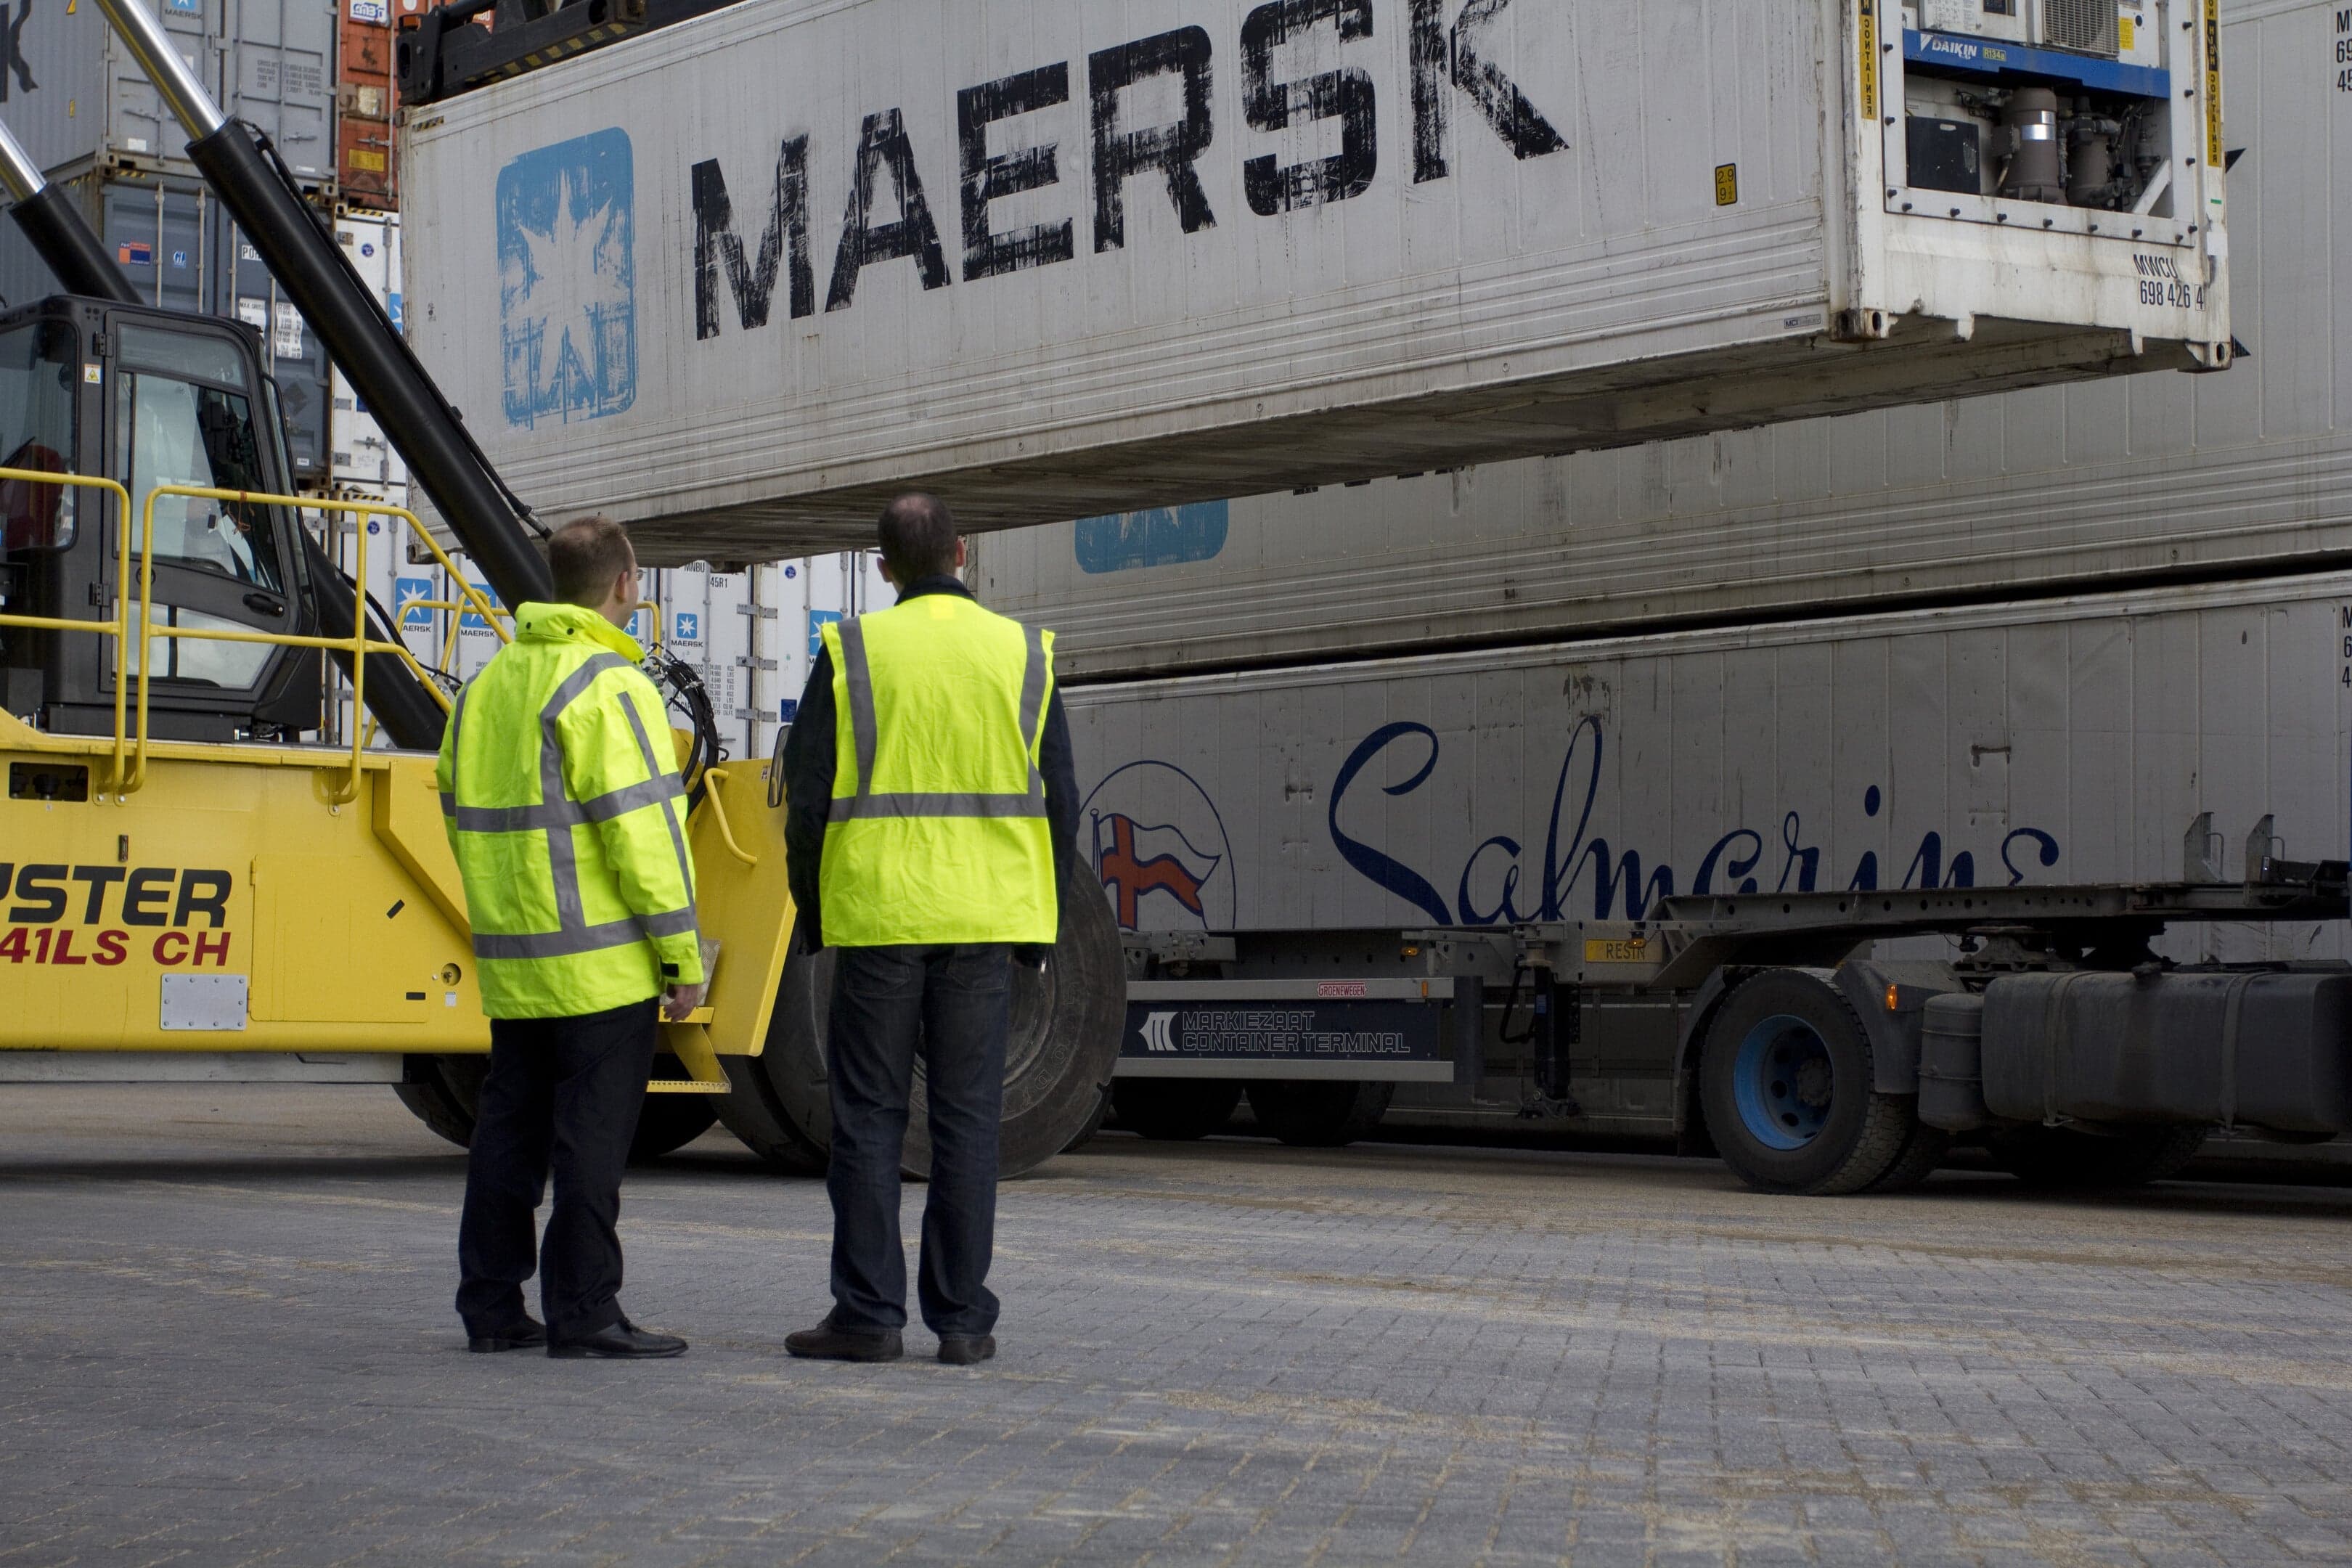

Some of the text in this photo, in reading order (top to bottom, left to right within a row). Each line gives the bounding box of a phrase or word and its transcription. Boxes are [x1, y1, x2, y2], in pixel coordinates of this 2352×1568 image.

[164, 8, 203, 20] MAERSK
[1932, 39, 1977, 57] DAIKIN
[691, 0, 1569, 340] MAERSK
[2133, 254, 2178, 279] MWCU
[2140, 280, 2204, 310] 698 426 4
[710, 576, 728, 589] 45R1
[403, 624, 432, 633] AERSK
[460, 629, 495, 638] MAERSK
[0, 862, 232, 928] STER
[152, 931, 232, 966] CH
[1318, 984, 1365, 996] GROENEWEGEN
[1183, 1011, 1315, 1031] MARKIEZAAT
[1183, 1032, 1410, 1053] CONTAINER TERMINAL
